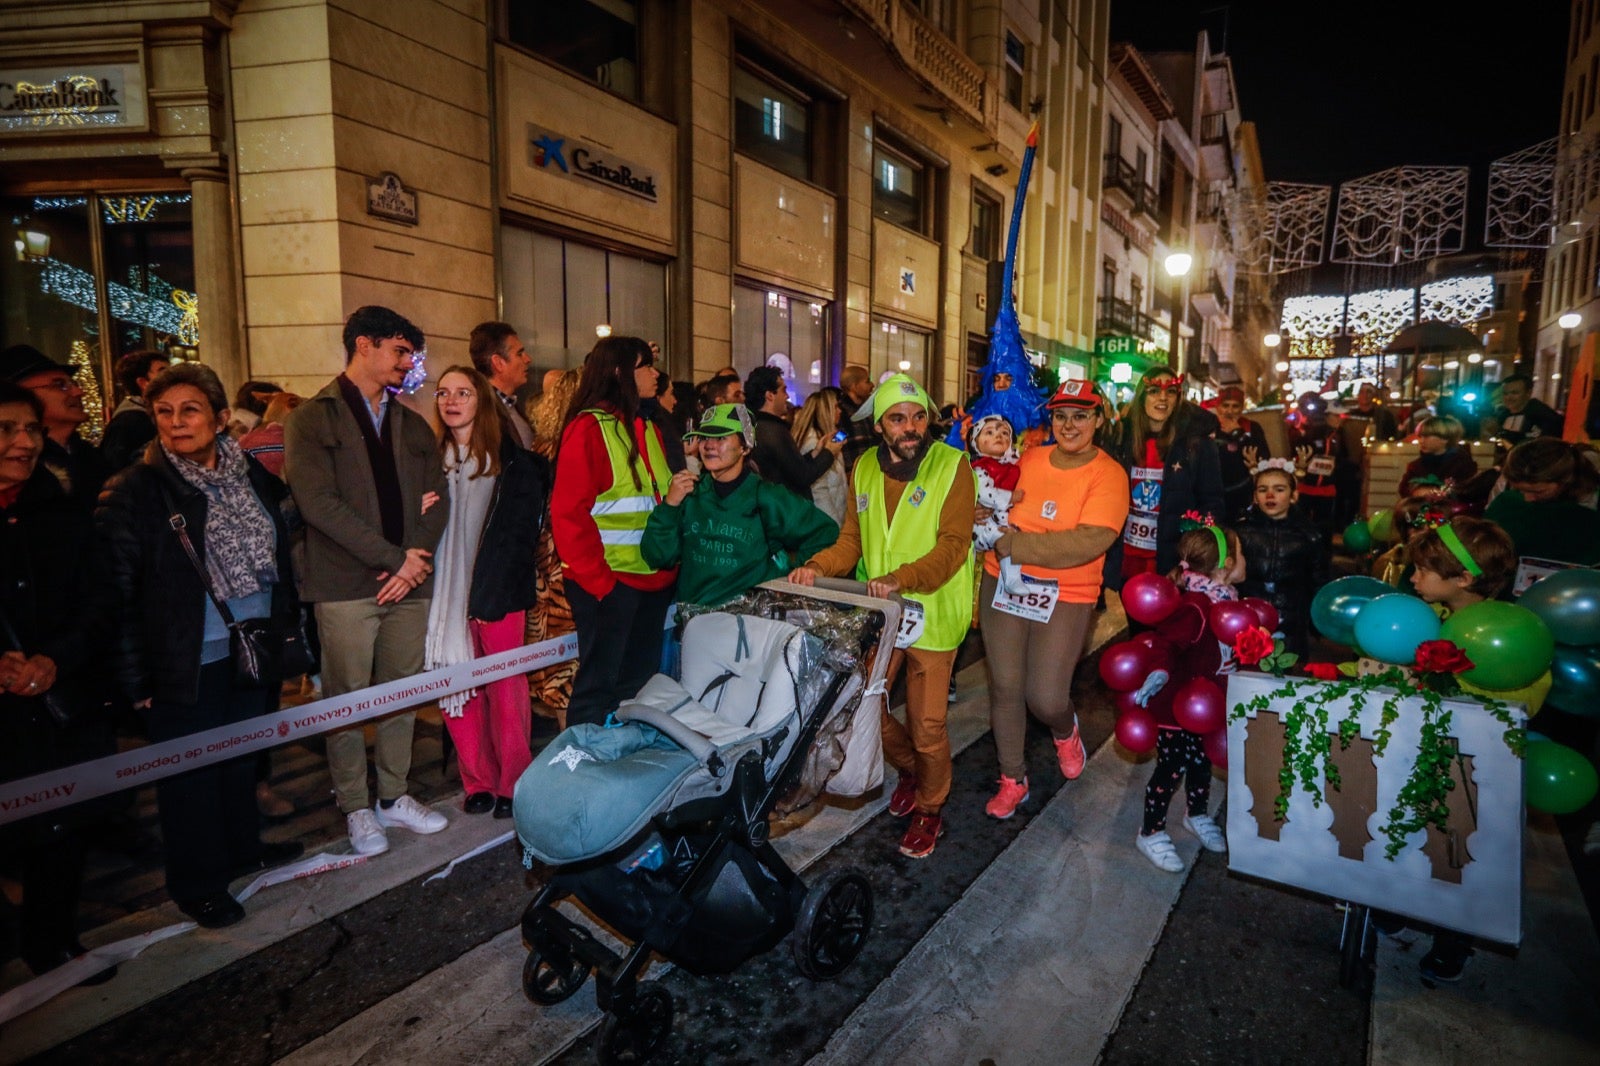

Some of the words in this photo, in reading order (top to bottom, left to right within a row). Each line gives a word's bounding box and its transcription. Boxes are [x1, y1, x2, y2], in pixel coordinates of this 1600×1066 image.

[573, 148, 657, 197] CaixaBank
[1099, 338, 1130, 353] 16H
[700, 538, 734, 553] PARIS
[472, 661, 506, 677] Deportes
[507, 659, 518, 668] de
[356, 701, 371, 712] DE
[184, 748, 203, 760] de
[115, 754, 181, 779] Deportes
